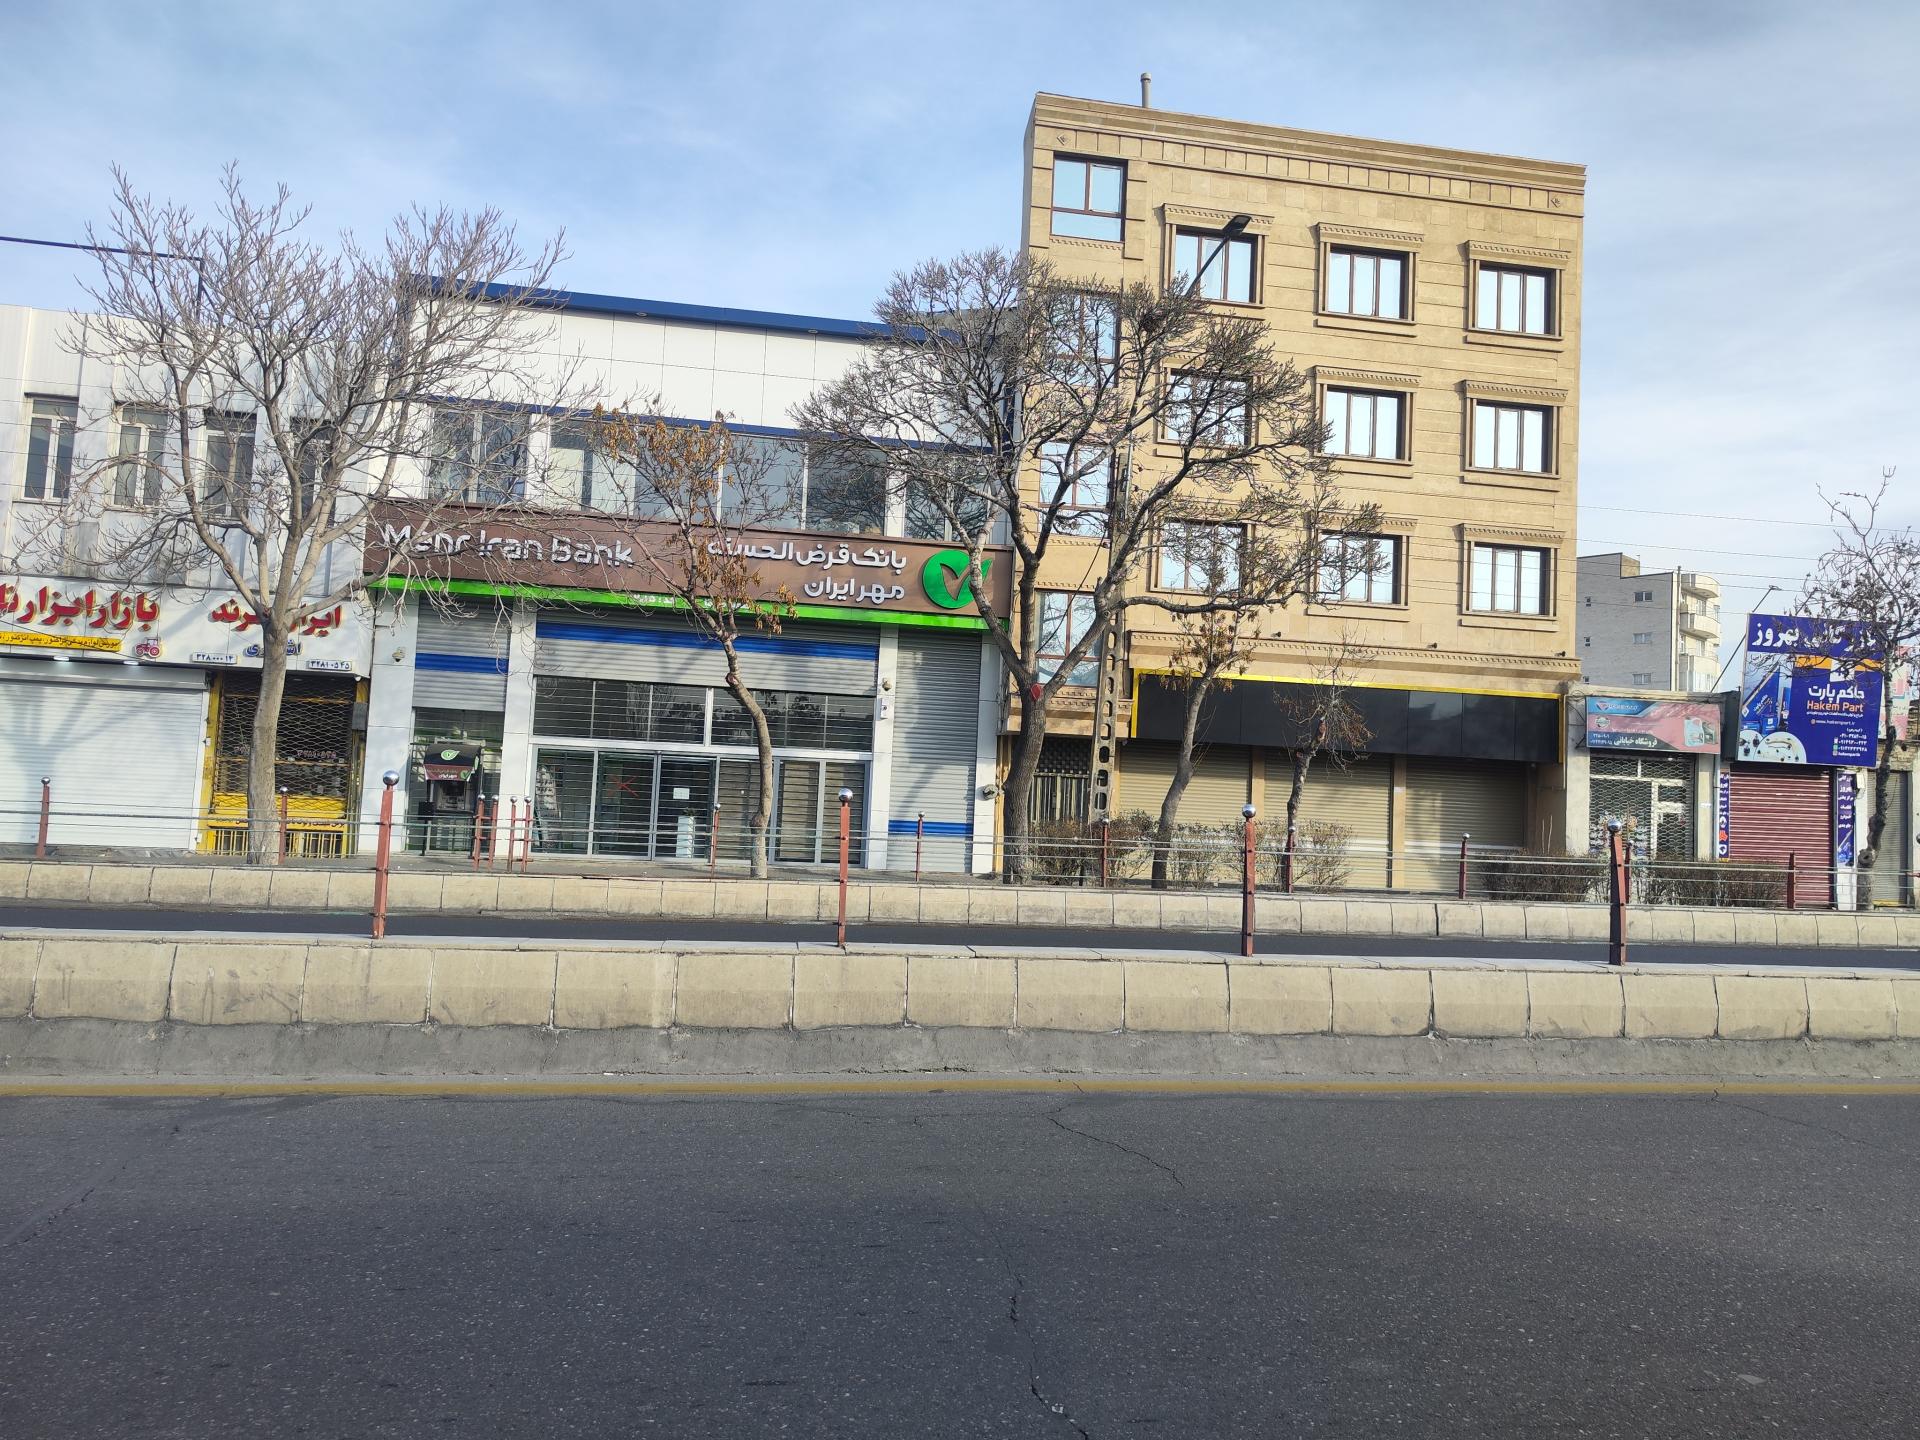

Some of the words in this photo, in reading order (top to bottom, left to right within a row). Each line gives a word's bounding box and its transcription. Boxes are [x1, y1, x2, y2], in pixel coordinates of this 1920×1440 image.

[479, 529, 543, 561] Iran
[551, 537, 634, 568] Bank
[795, 543, 850, 570] قرض
[851, 546, 907, 574] بانک
[804, 577, 855, 601] ایران
[857, 584, 905, 606] مهر
[1751, 622, 1799, 648] بهروز
[1808, 683, 1836, 703] پارت
[1836, 684, 1865, 704] حاکم
[1807, 700, 1840, 711] Hakem
[1842, 702, 1864, 712] Part
[1635, 737, 1658, 747] فروشگاه
